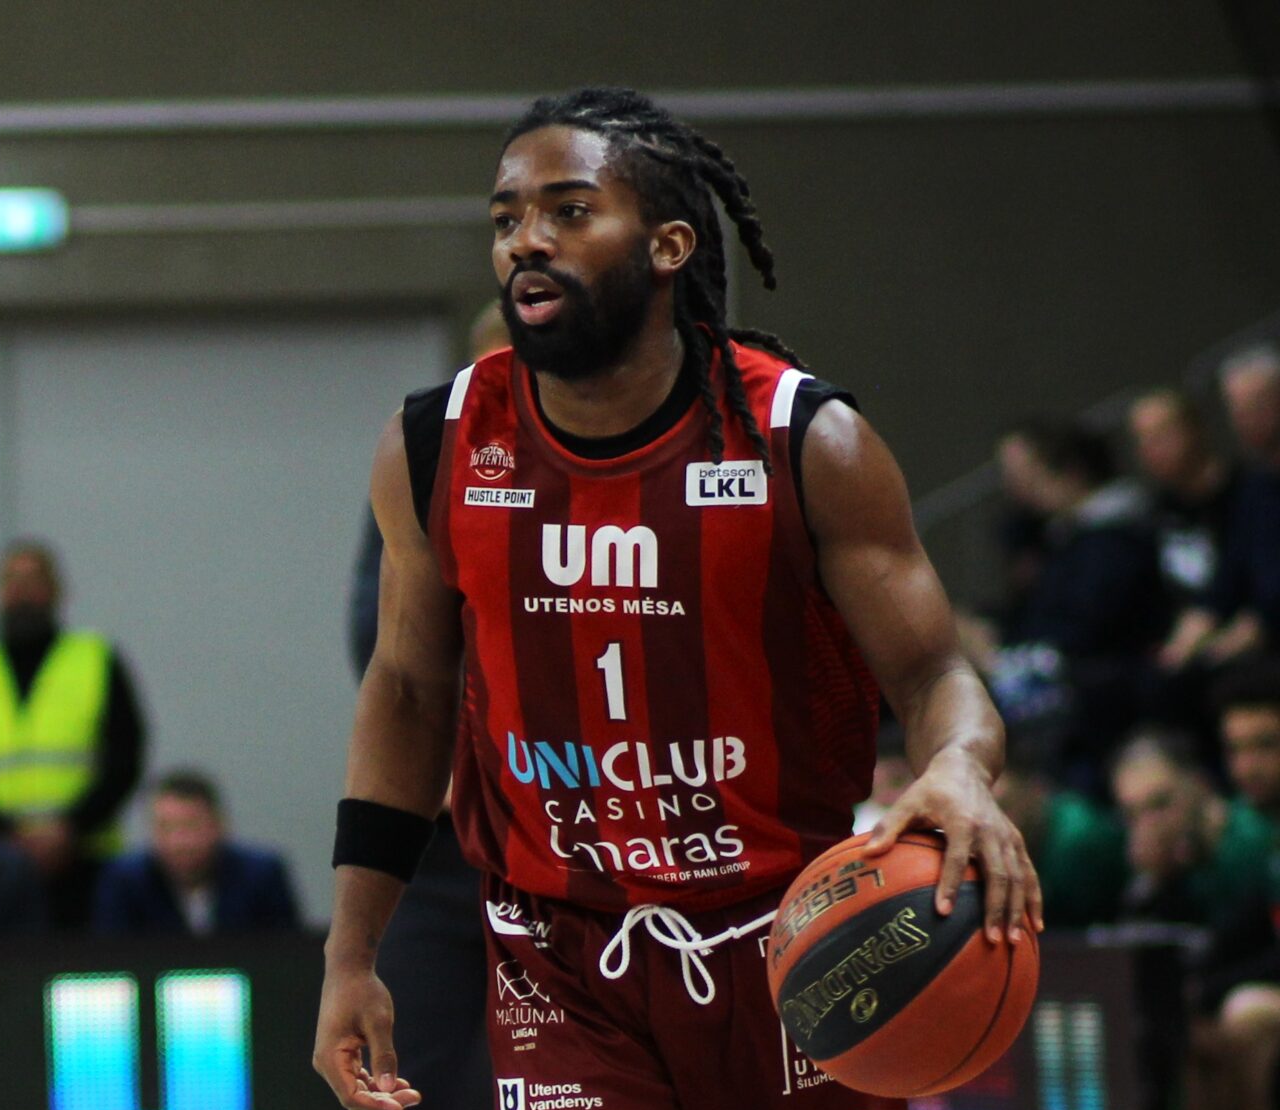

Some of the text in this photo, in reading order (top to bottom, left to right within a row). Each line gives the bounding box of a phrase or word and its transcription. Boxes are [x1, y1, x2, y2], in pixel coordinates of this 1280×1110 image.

[699, 468, 755, 478] betsson
[468, 490, 532, 505] HUSTLE POINT
[699, 478, 755, 498] LKL
[524, 597, 686, 615] UTENOS MĖSA
[596, 642, 627, 721] 1
[507, 731, 747, 791] UNICLUB
[545, 794, 716, 824] CASINO
[679, 870, 693, 881] OF
[694, 867, 718, 879] RANI
[720, 860, 751, 875] GROUP
[529, 1083, 582, 1097] Utenos
[530, 1096, 603, 1110] vandenys
